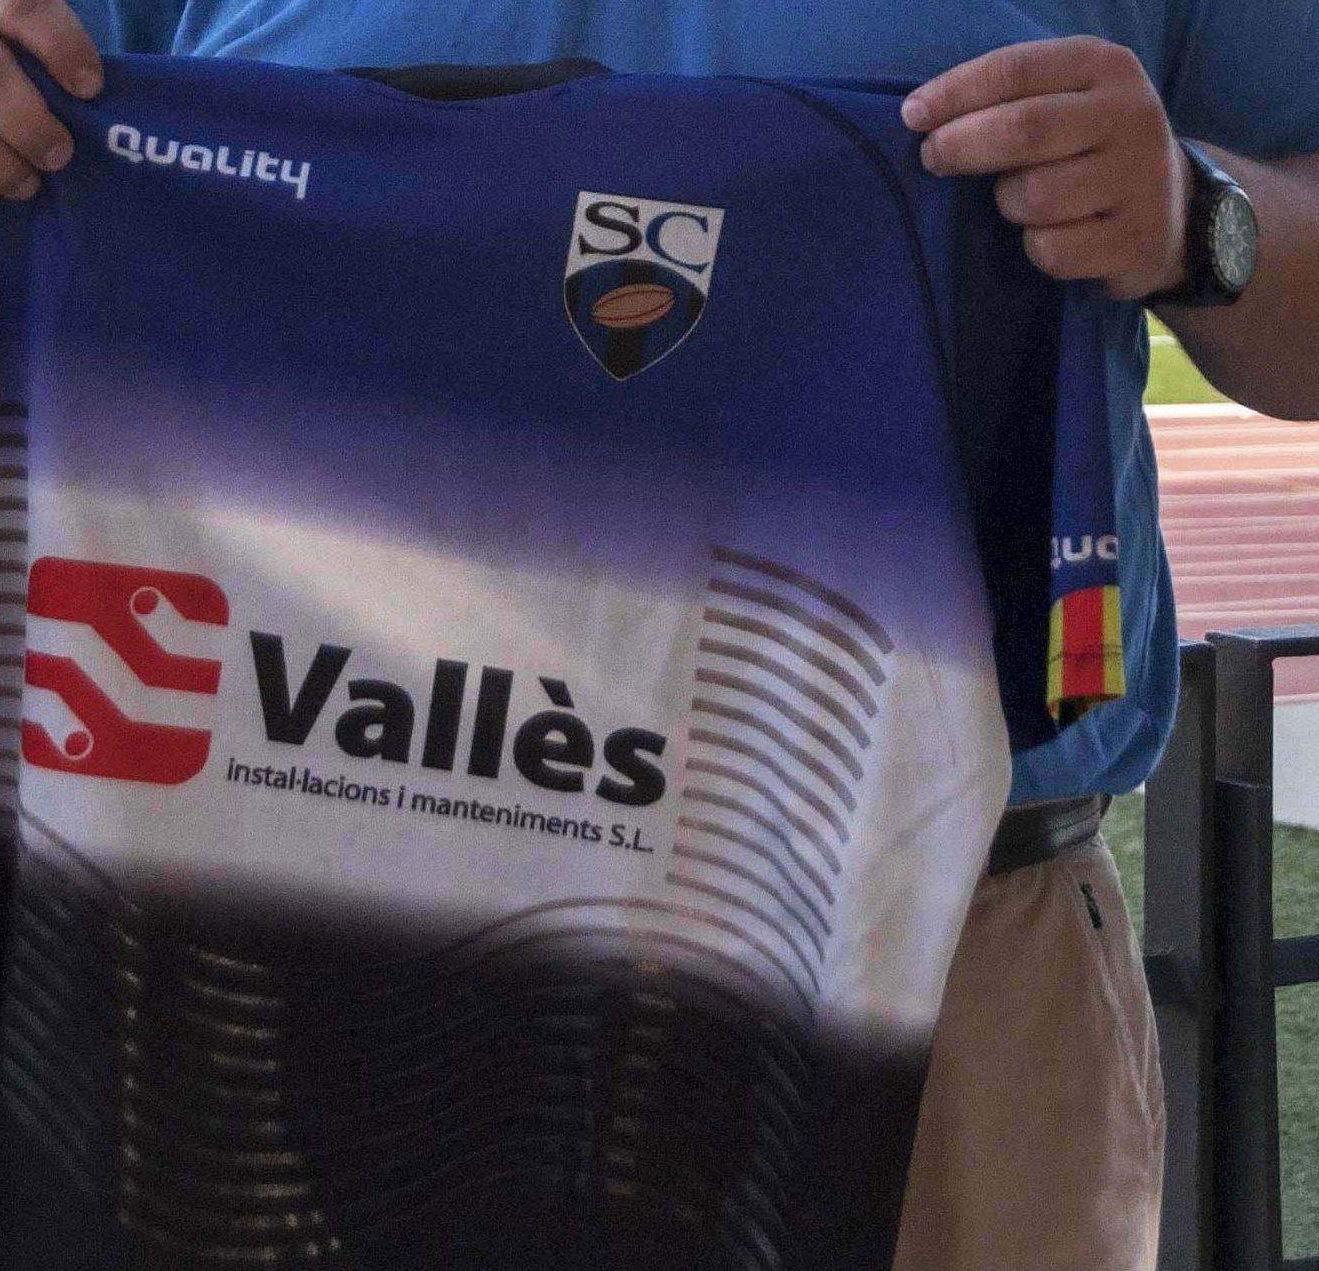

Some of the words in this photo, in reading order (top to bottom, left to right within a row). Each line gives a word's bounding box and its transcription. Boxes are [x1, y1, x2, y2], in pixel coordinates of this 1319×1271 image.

[107, 123, 311, 200] Quality
[578, 201, 709, 274] SC
[249, 631, 667, 807] Vallès
[396, 785, 405, 809] i
[411, 792, 602, 842] manteniments
[608, 823, 654, 853] S.L.
